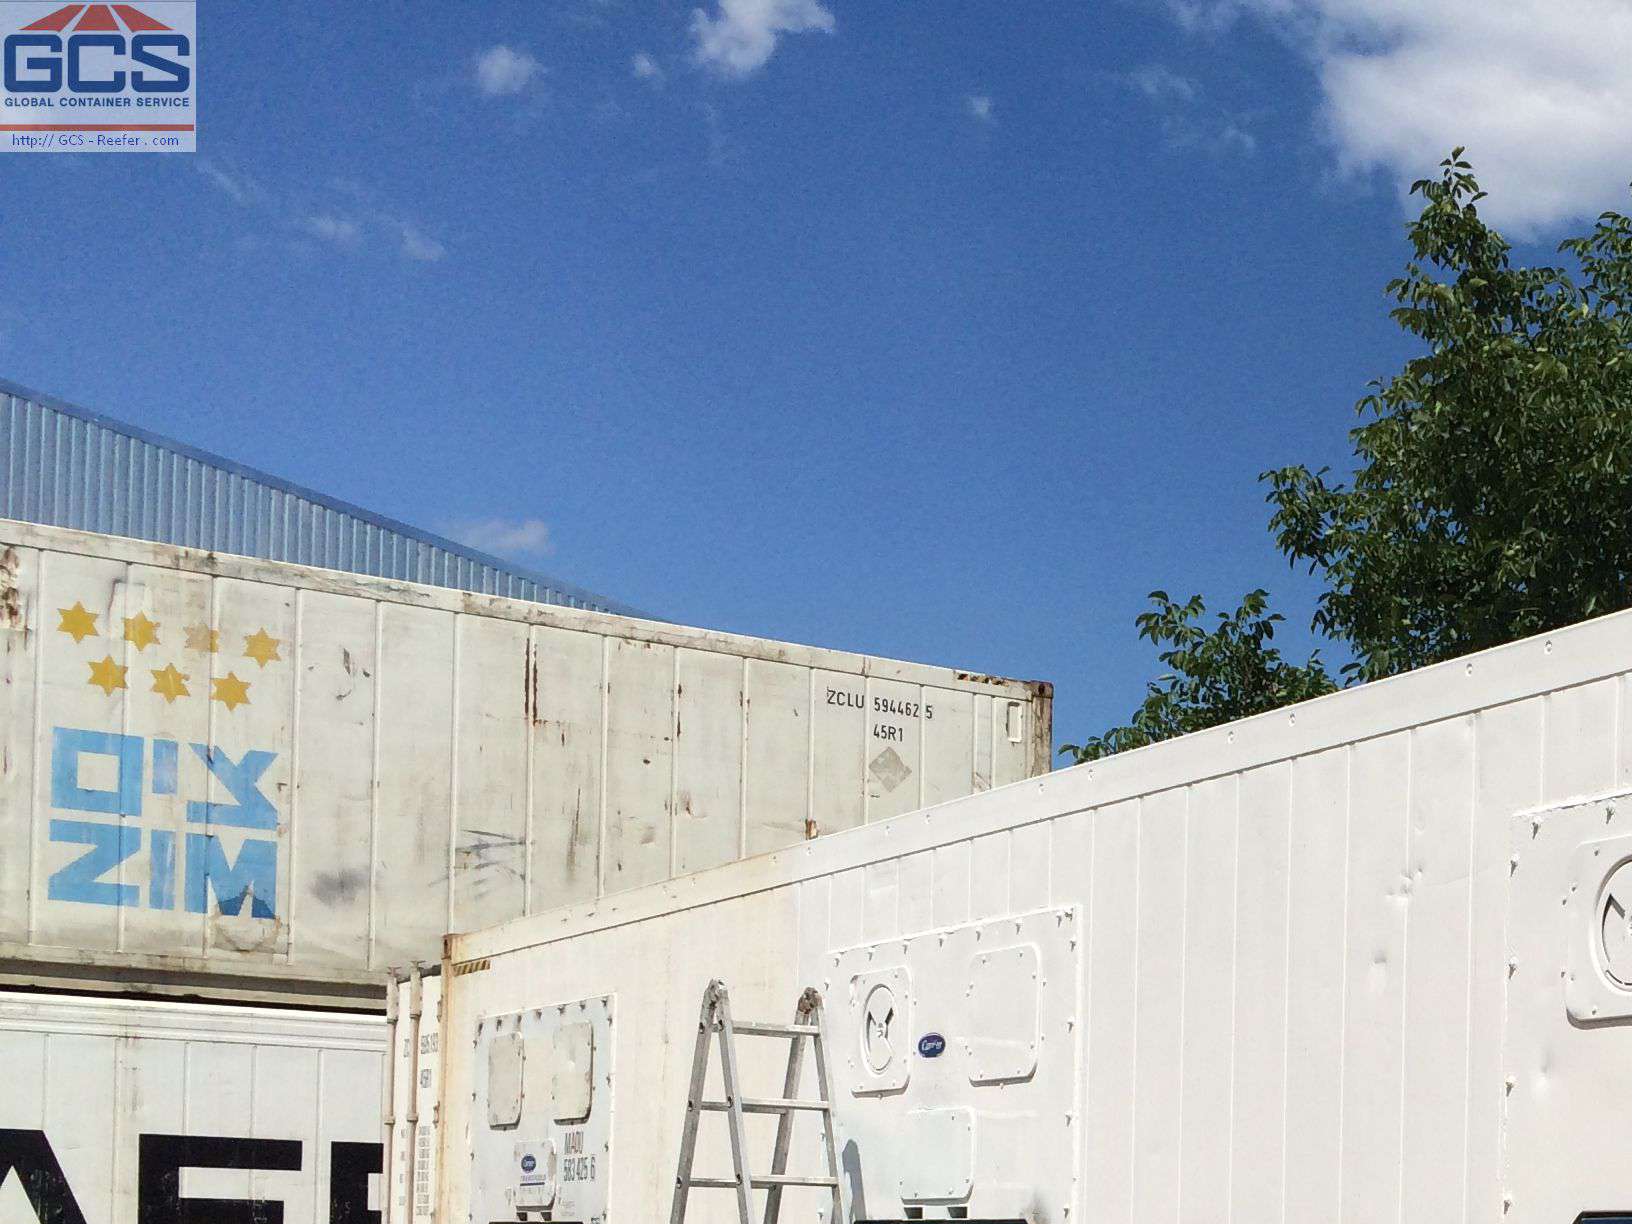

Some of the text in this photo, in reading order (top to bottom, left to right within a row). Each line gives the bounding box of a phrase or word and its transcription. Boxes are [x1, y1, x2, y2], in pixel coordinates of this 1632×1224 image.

[827, 688, 933, 719] ZCLU 594462 5
[873, 723, 903, 742] 45R1
[48, 818, 278, 919] ZIM
